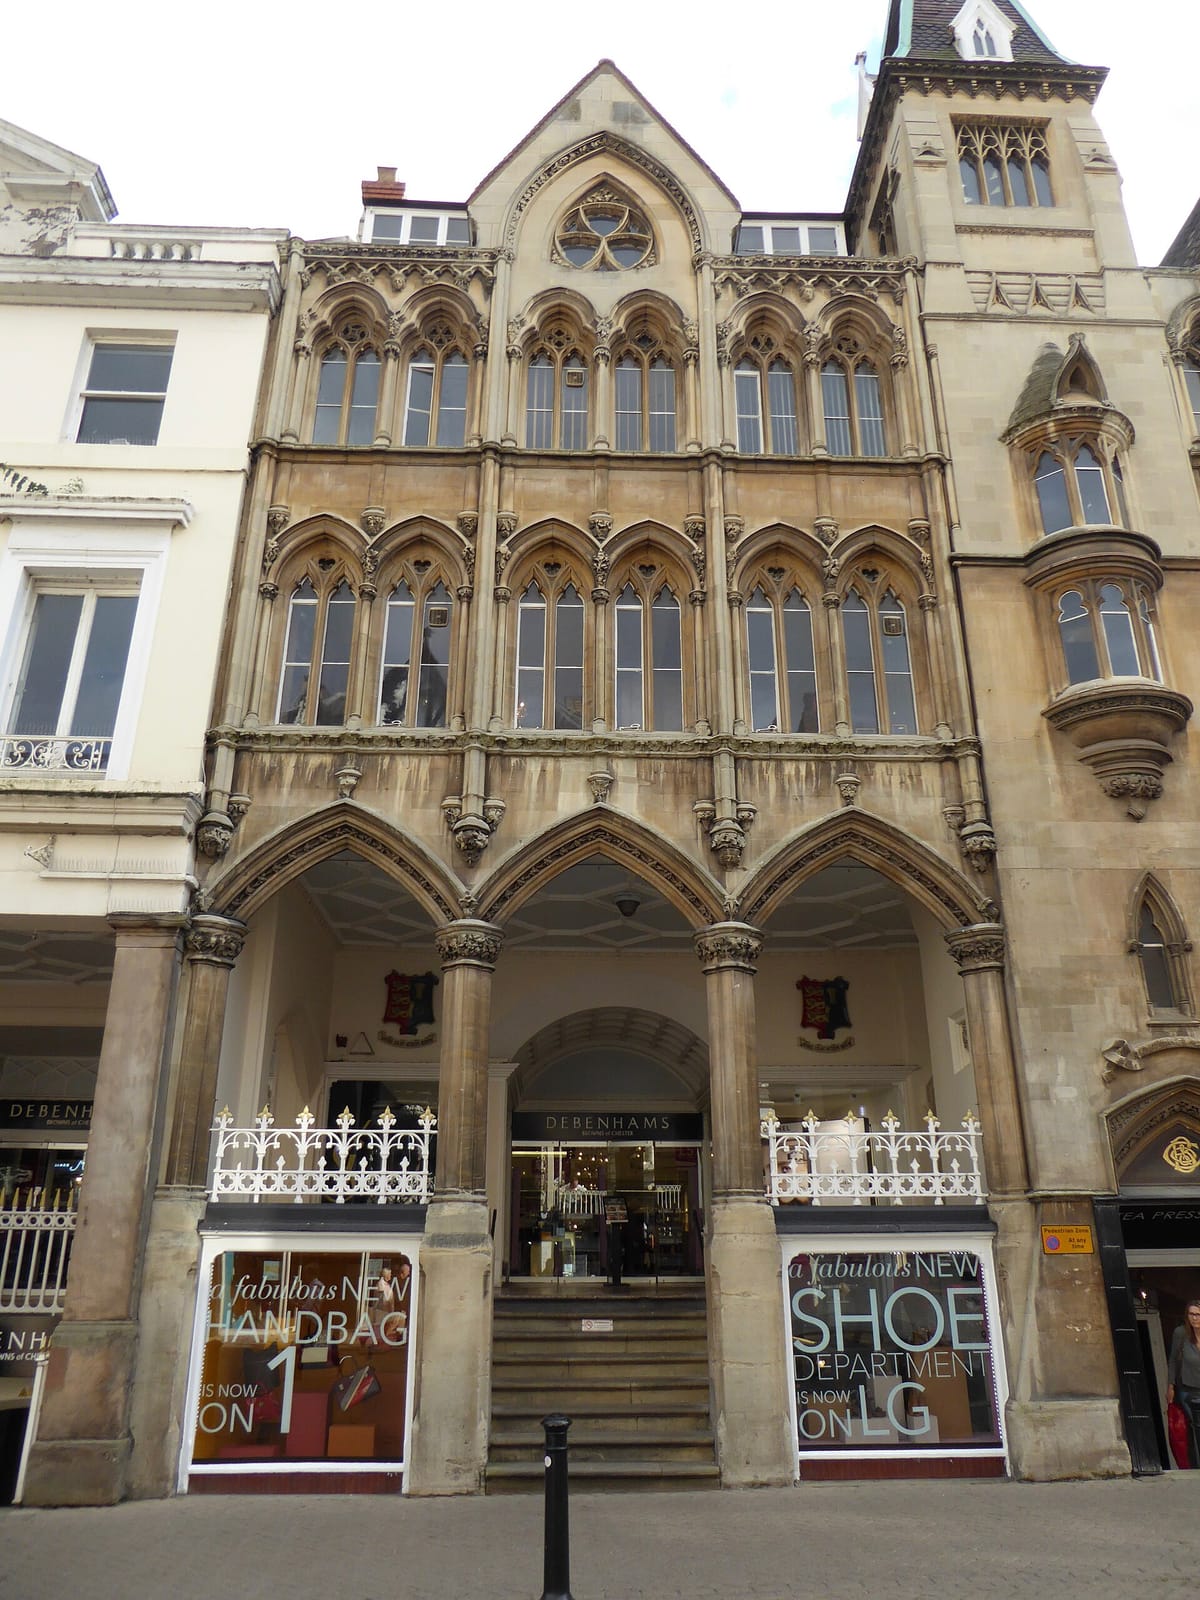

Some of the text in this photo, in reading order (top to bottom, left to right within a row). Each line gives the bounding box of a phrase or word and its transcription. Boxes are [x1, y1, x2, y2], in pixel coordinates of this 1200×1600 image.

[546, 1116, 670, 1129] DEBENHAMS
[789, 1253, 980, 1286] a fabulous NEW
[209, 1274, 410, 1307] a fabulous NEW
[206, 1310, 408, 1346] HANDBAG
[791, 1286, 990, 1354] SHOE
[0, 1331, 46, 1350] NH
[793, 1351, 991, 1381] DEPARTMENT
[199, 1346, 296, 1434] ON 1
[201, 1384, 258, 1398] IS NOW
[797, 1389, 850, 1405] IS NOW
[799, 1381, 931, 1439] ON LG
